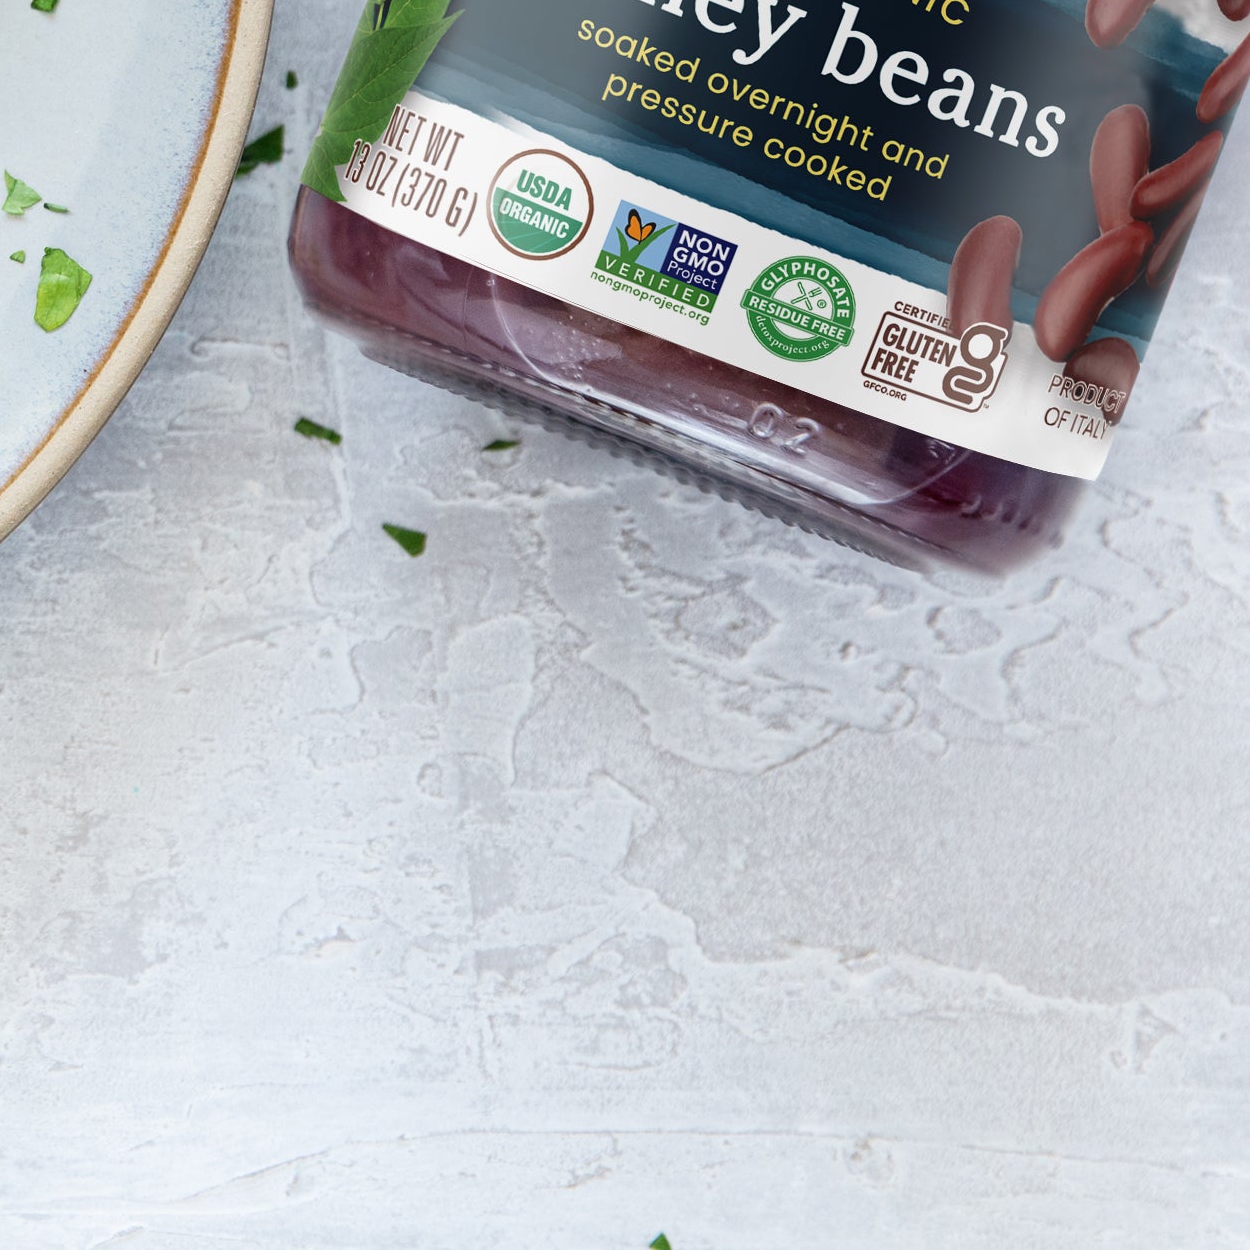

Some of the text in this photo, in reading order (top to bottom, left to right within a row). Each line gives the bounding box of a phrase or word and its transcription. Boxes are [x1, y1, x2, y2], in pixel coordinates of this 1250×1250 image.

[577, 17, 950, 180] soaked overnight and
[821, 1, 1067, 159] beans
[383, 104, 465, 171] NET WT
[601, 72, 893, 201] pressure cooked
[344, 139, 478, 237] 13 OZ (370 G)
[516, 169, 573, 212] USDA
[499, 197, 570, 239] ORGANIC
[673, 247, 724, 276] GMO
[679, 229, 730, 261] NON
[605, 255, 710, 308] VERIFIED
[667, 260, 718, 290] Project
[761, 262, 850, 318] GLYPHOSATE
[590, 270, 710, 326] nongmoproject.org
[749, 295, 846, 341] RESIDUE FREE
[756, 315, 830, 354] detoxproject.org
[882, 323, 957, 367] GLUTEN
[871, 347, 919, 383] FREE
[863, 380, 907, 401] GFCO.ORG
[1047, 374, 1126, 414] PRODUCT
[1044, 406, 1111, 440] OF ITALY
